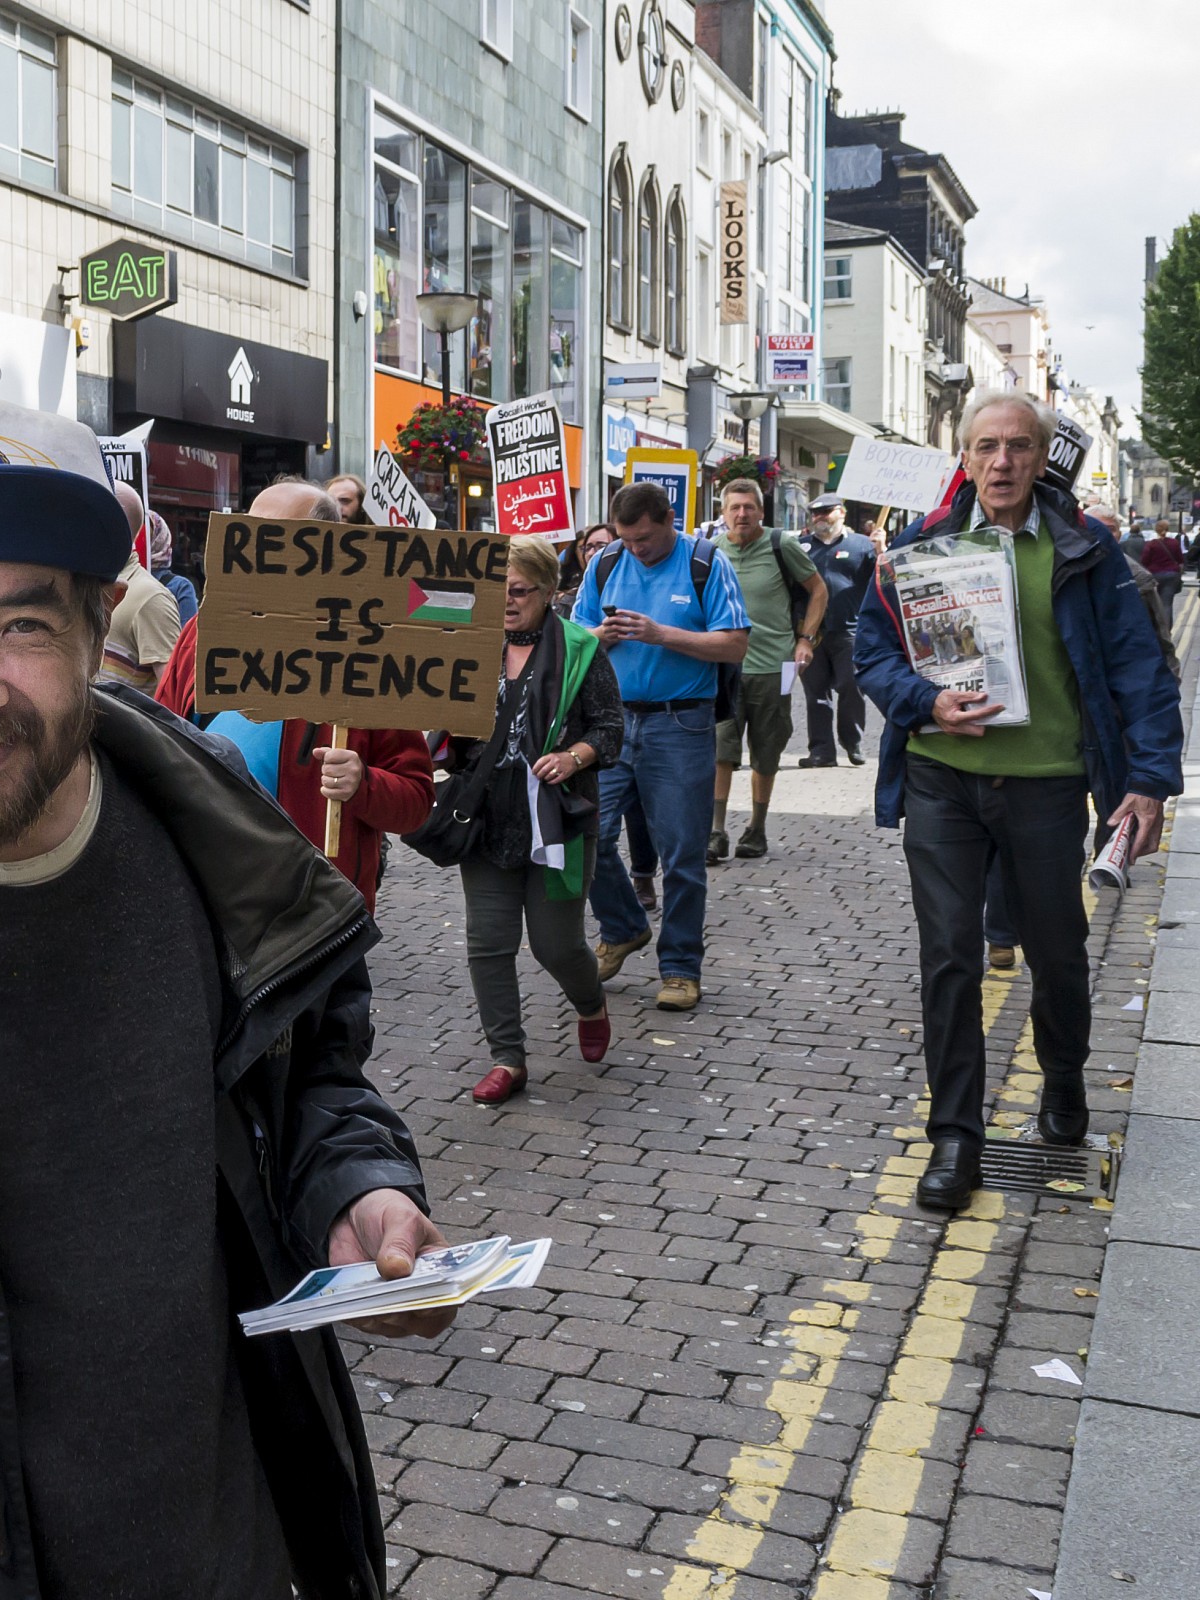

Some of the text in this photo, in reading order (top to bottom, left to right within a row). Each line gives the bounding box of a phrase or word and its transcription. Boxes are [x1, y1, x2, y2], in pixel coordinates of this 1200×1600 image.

[723, 200, 746, 300] LOOKS
[87, 252, 165, 301] EAT
[226, 407, 255, 424] HOUSE
[496, 411, 555, 448] FREEDOM
[100, 441, 127, 451] orker
[609, 424, 635, 451] LINEN
[496, 445, 562, 484] PALESTINE
[865, 444, 945, 470] BOYCOTT
[857, 484, 924, 505] SPENCER
[222, 521, 511, 583] RESISTANCE
[908, 594, 954, 616] Socialist
[955, 588, 1002, 607] Worker
[315, 597, 384, 645] IS
[204, 647, 479, 702] EXISTENCE
